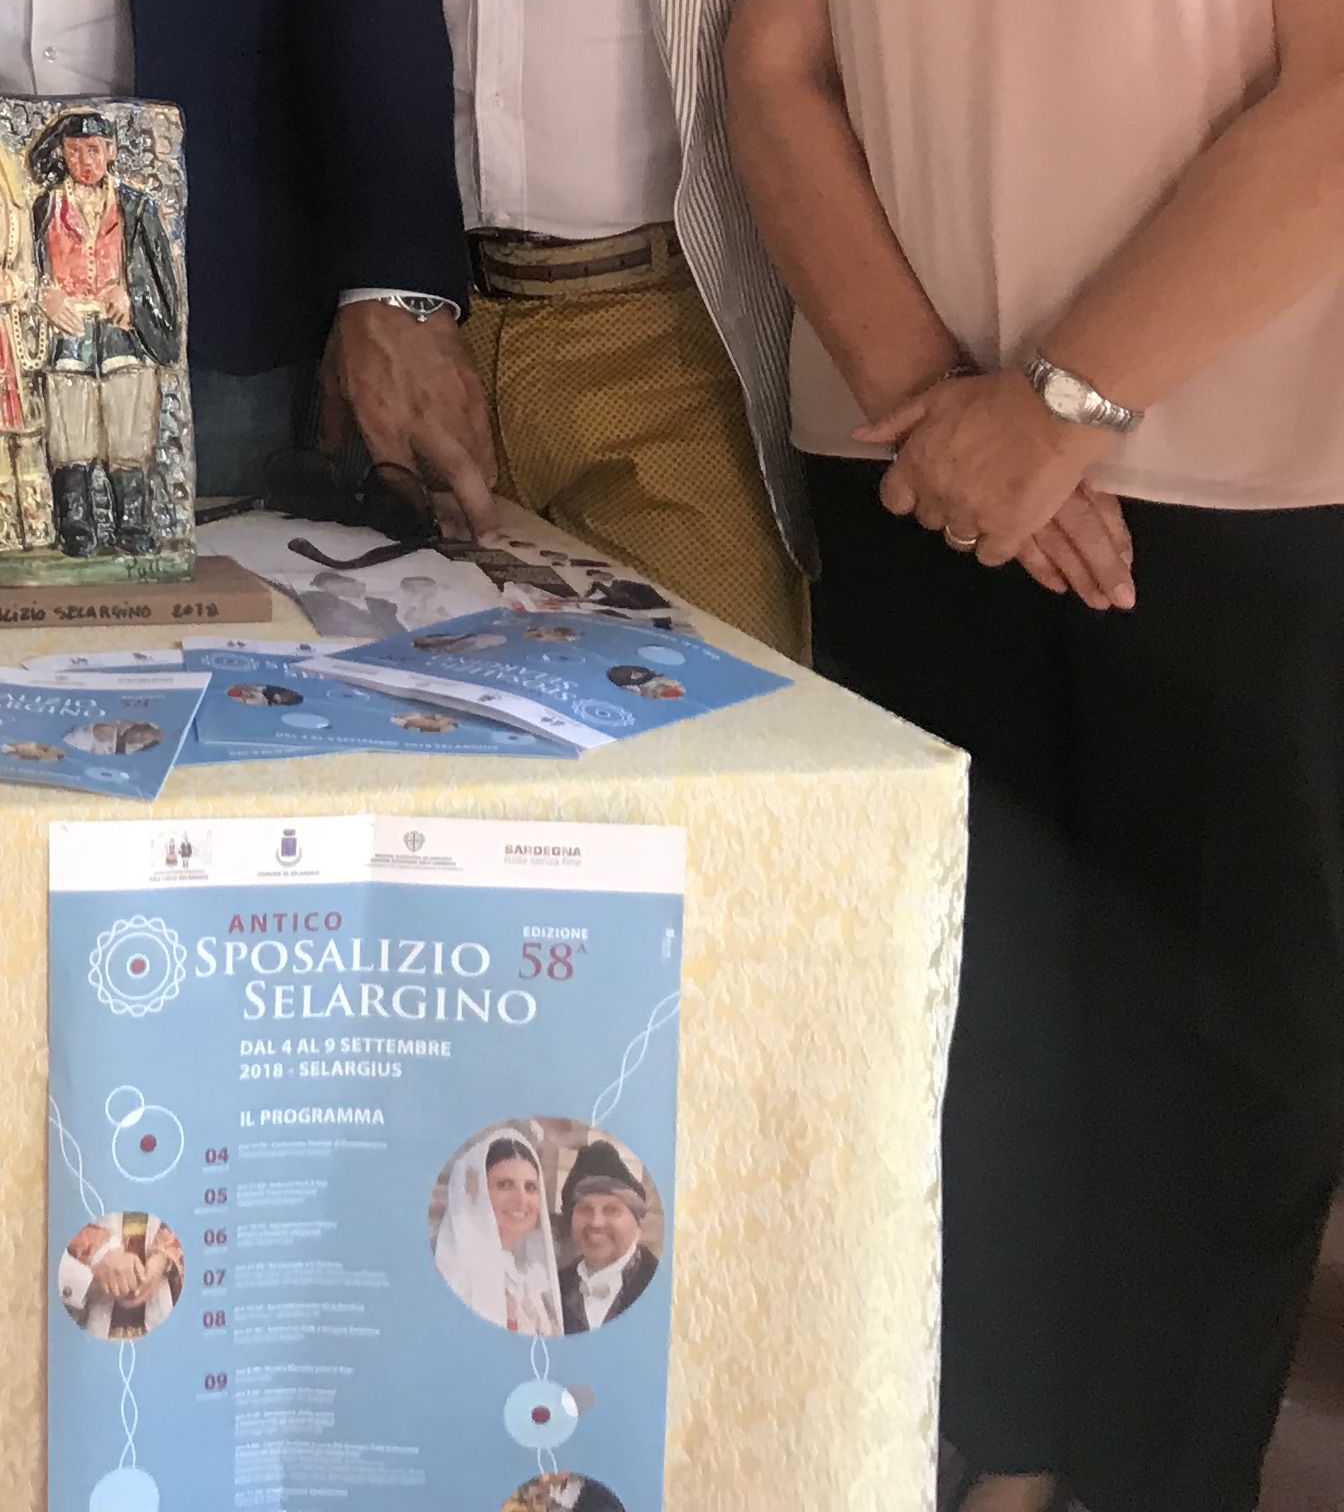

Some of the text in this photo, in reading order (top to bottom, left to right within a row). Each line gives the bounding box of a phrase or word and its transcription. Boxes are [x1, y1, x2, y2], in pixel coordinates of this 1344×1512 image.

[505, 844, 582, 857] SARDEGNA
[228, 911, 342, 933] ANTICO
[523, 926, 588, 940] EDIZIONE
[195, 936, 490, 978] SPOSALIZIO
[244, 980, 536, 1024] SELARGINO
[240, 1037, 451, 1057] DAL 4 AL 9 SETTEMBRE
[239, 1063, 283, 1079] 2018
[299, 1061, 402, 1077] SELARGIUS
[240, 1107, 384, 1127] IL PROGRAMMA
[205, 1147, 229, 1164] 04
[204, 1188, 227, 1205] 05
[204, 1228, 227, 1246] 06
[203, 1269, 226, 1286] 07
[203, 1311, 225, 1328] 08
[204, 1373, 227, 1390] 09
